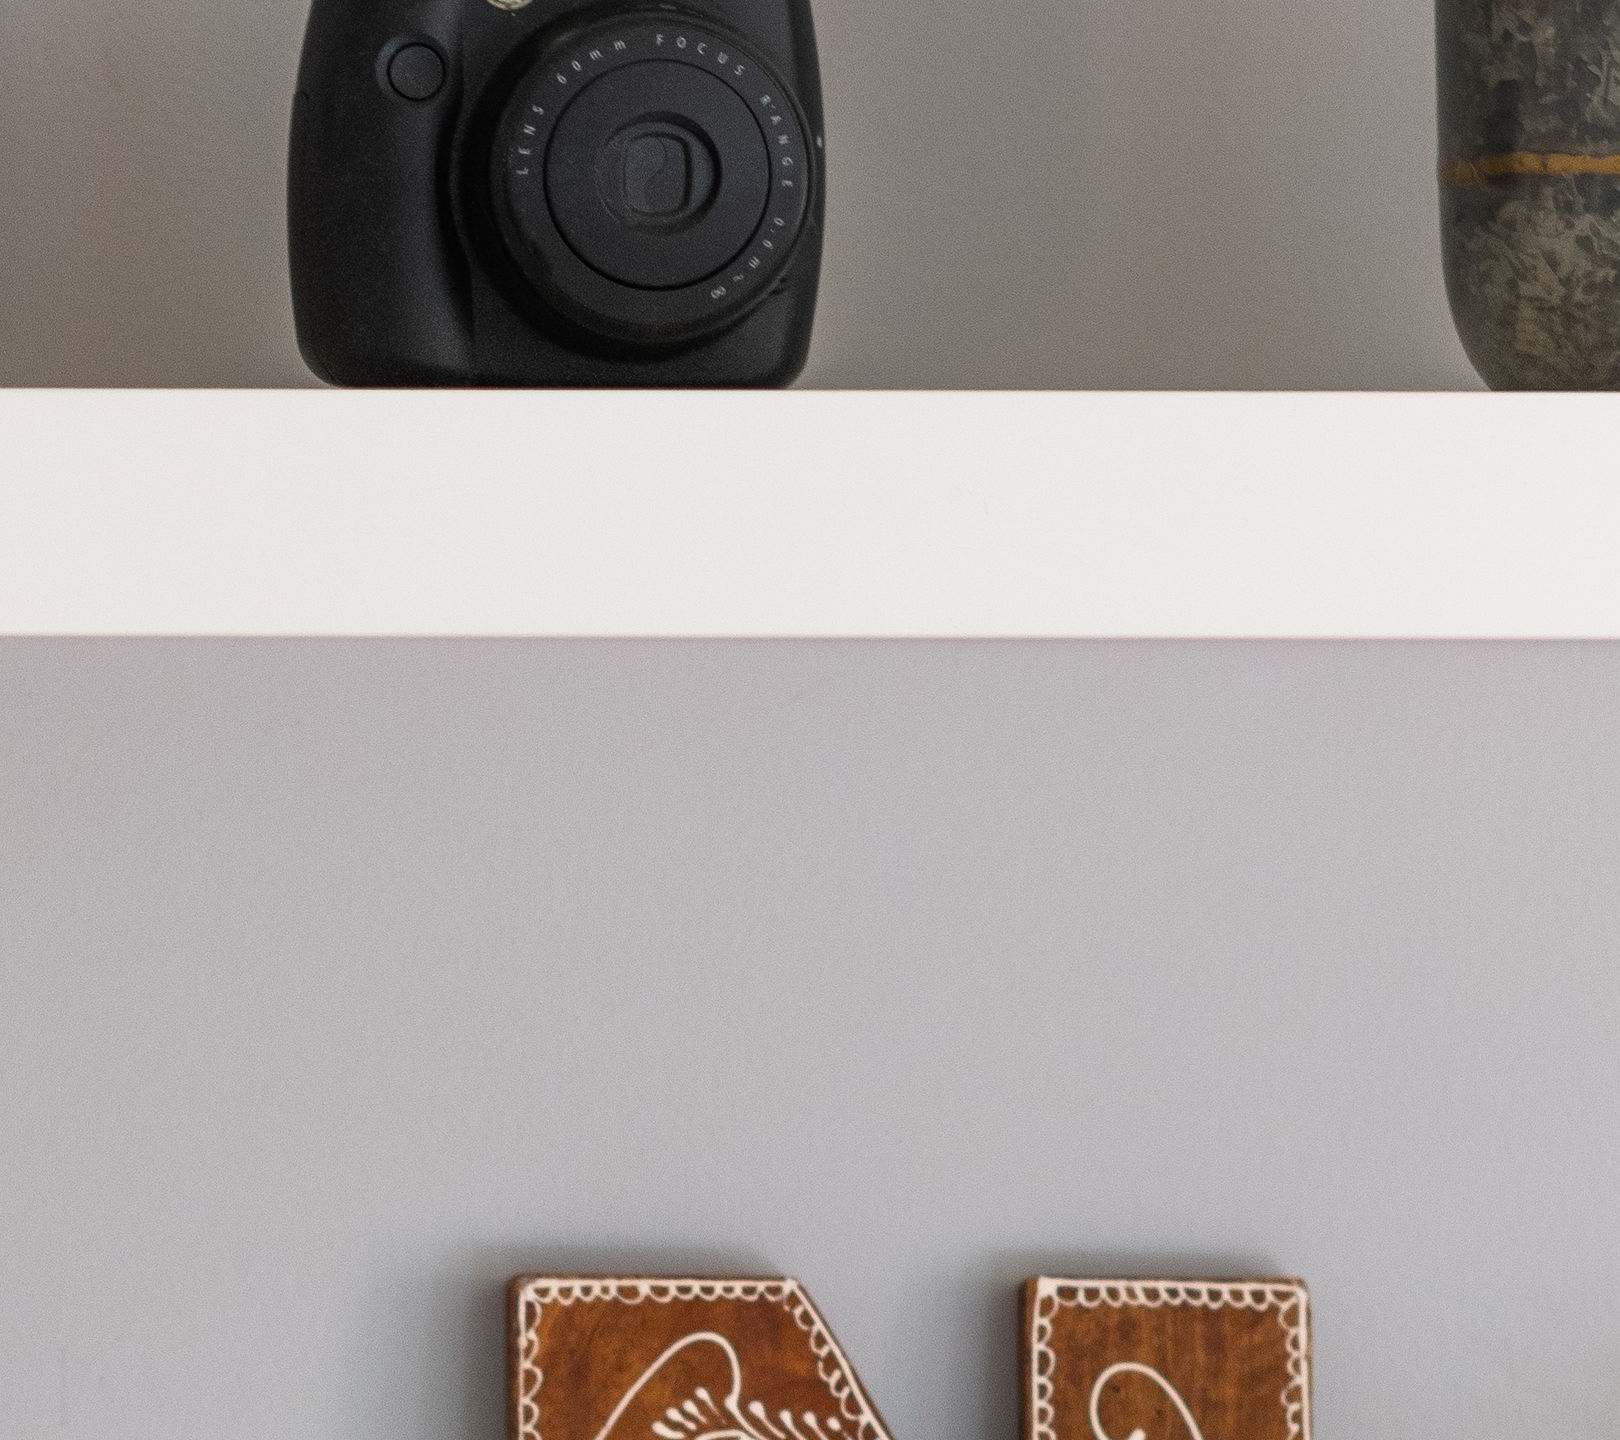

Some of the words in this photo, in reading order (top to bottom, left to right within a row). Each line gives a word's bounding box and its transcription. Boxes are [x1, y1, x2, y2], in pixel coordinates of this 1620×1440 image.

[516, 104, 544, 176] LENS
[556, 40, 626, 85] 60mm
[655, 33, 746, 77] FOCUS
[760, 94, 793, 188] RANGE
